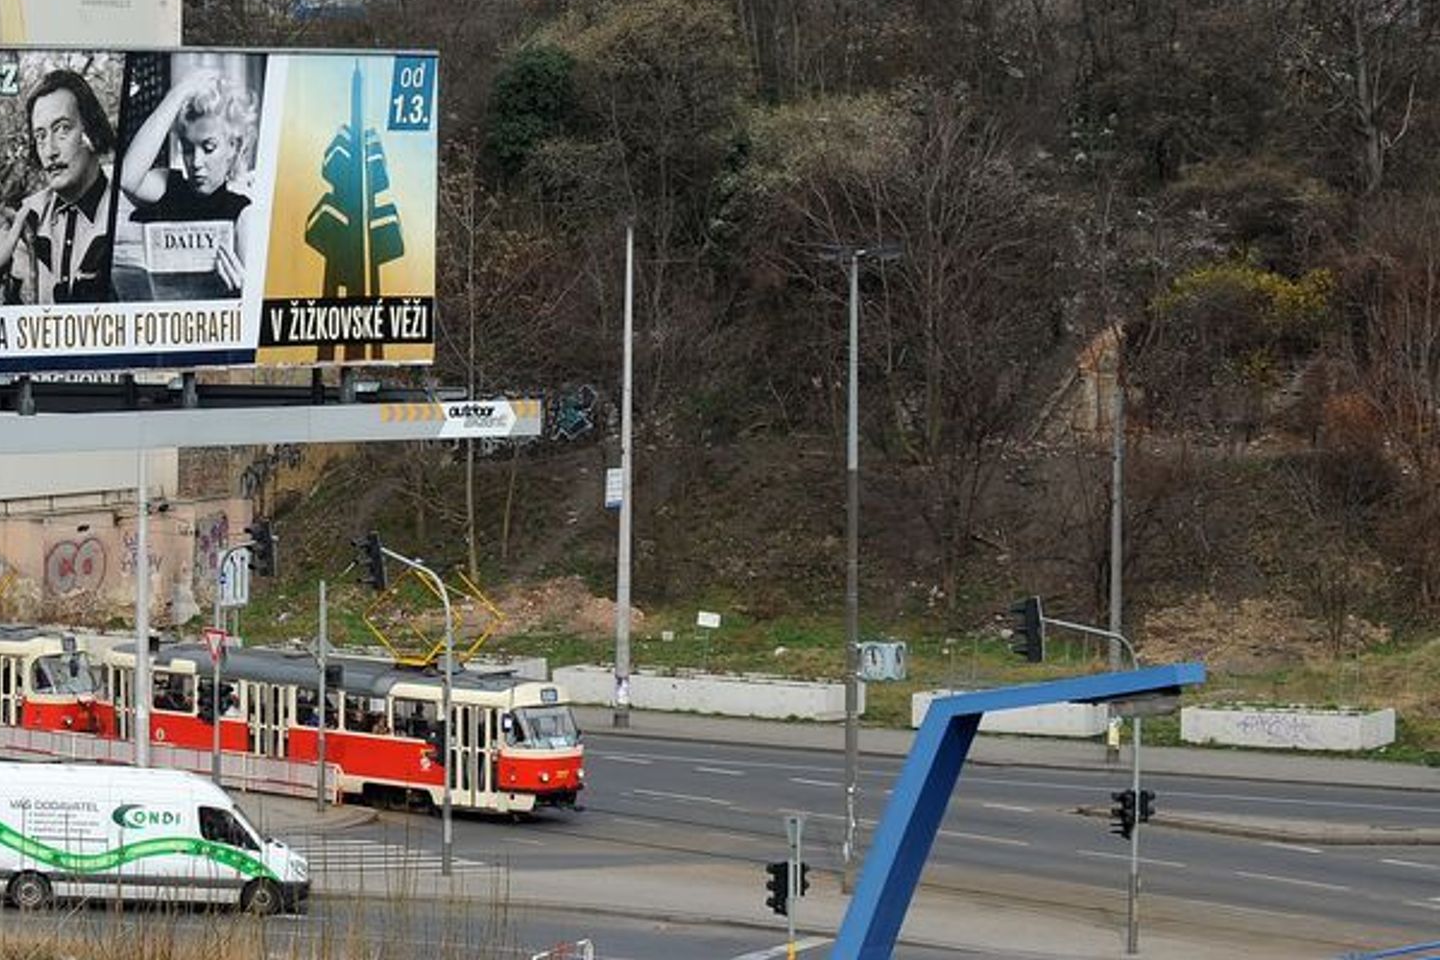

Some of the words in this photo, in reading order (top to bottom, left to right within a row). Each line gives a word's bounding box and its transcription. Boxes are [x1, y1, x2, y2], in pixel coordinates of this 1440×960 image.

[393, 94, 429, 124] 1.3.
[164, 233, 215, 250] DAILY
[17, 307, 126, 349] SVĚTOVÝCH
[134, 303, 243, 346] FOTOGRAFIÍ
[270, 308, 283, 341] V
[288, 299, 384, 340] ŽIŽKOVSKÉ
[389, 297, 427, 338] VĚŽI
